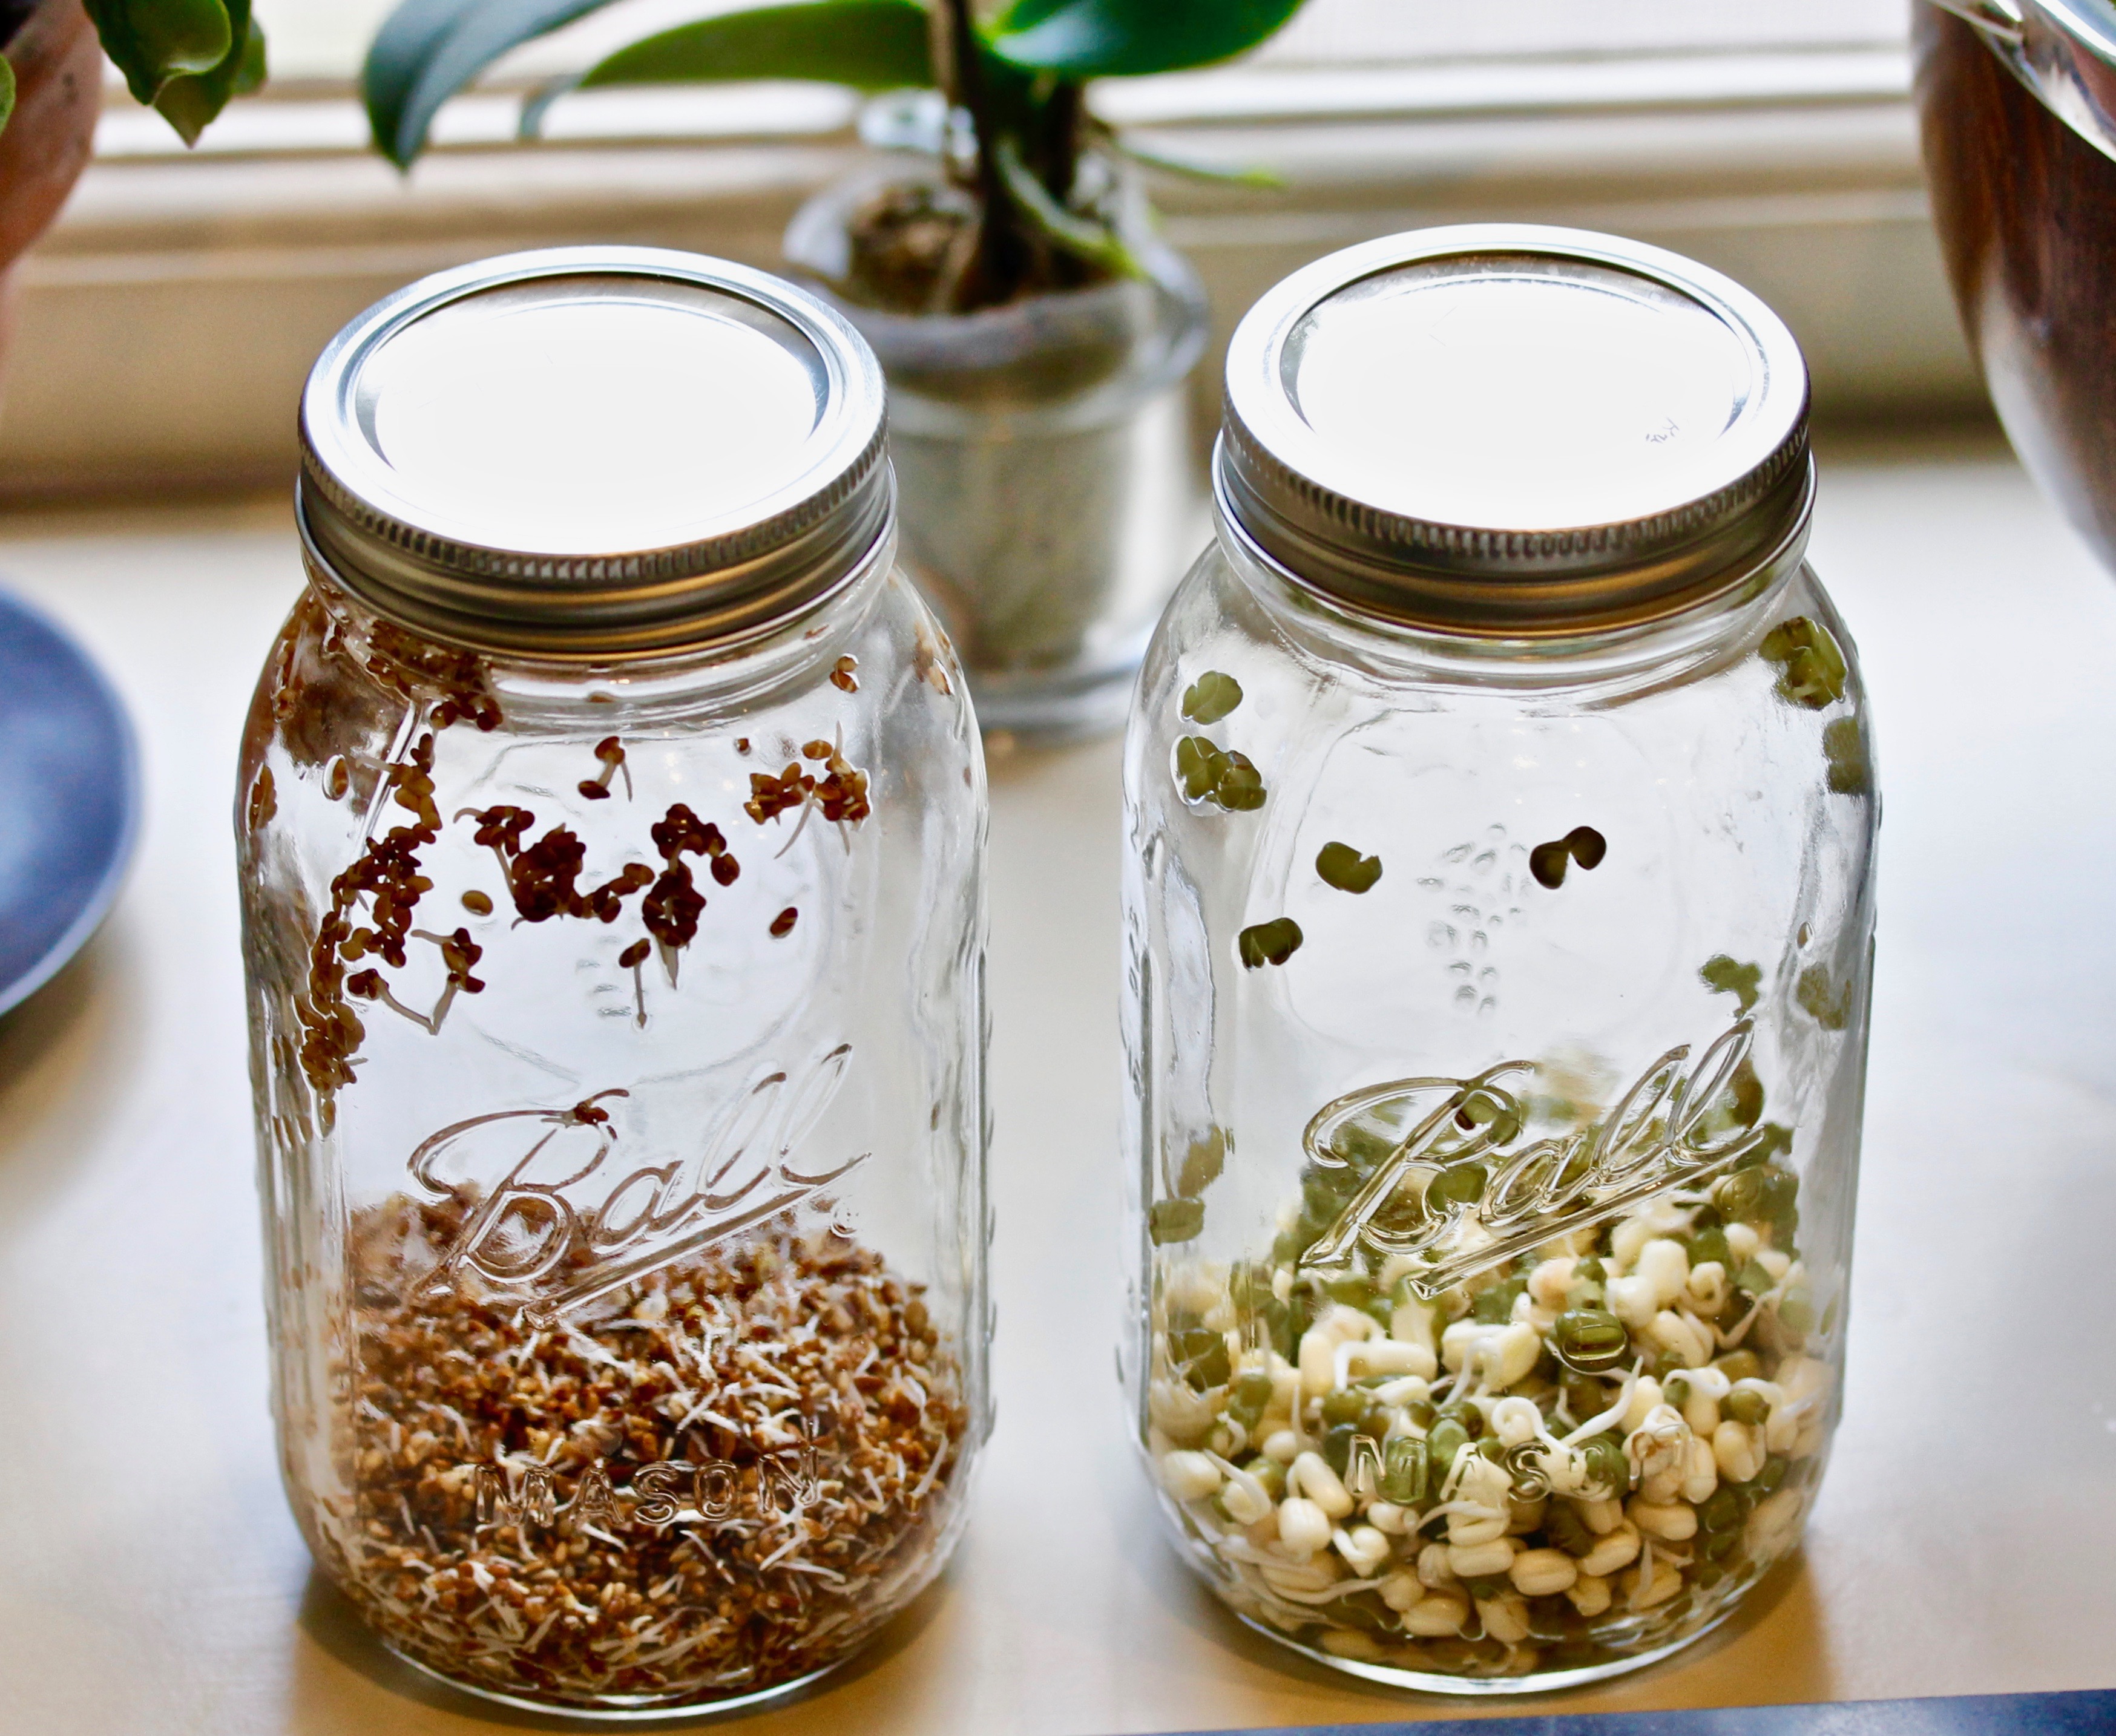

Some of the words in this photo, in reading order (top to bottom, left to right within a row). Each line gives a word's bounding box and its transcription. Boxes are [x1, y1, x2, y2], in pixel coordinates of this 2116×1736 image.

[408, 1043, 870, 1325] Ball
[1301, 1014, 1764, 1299] Ball
[475, 1446, 818, 1527] MASON
